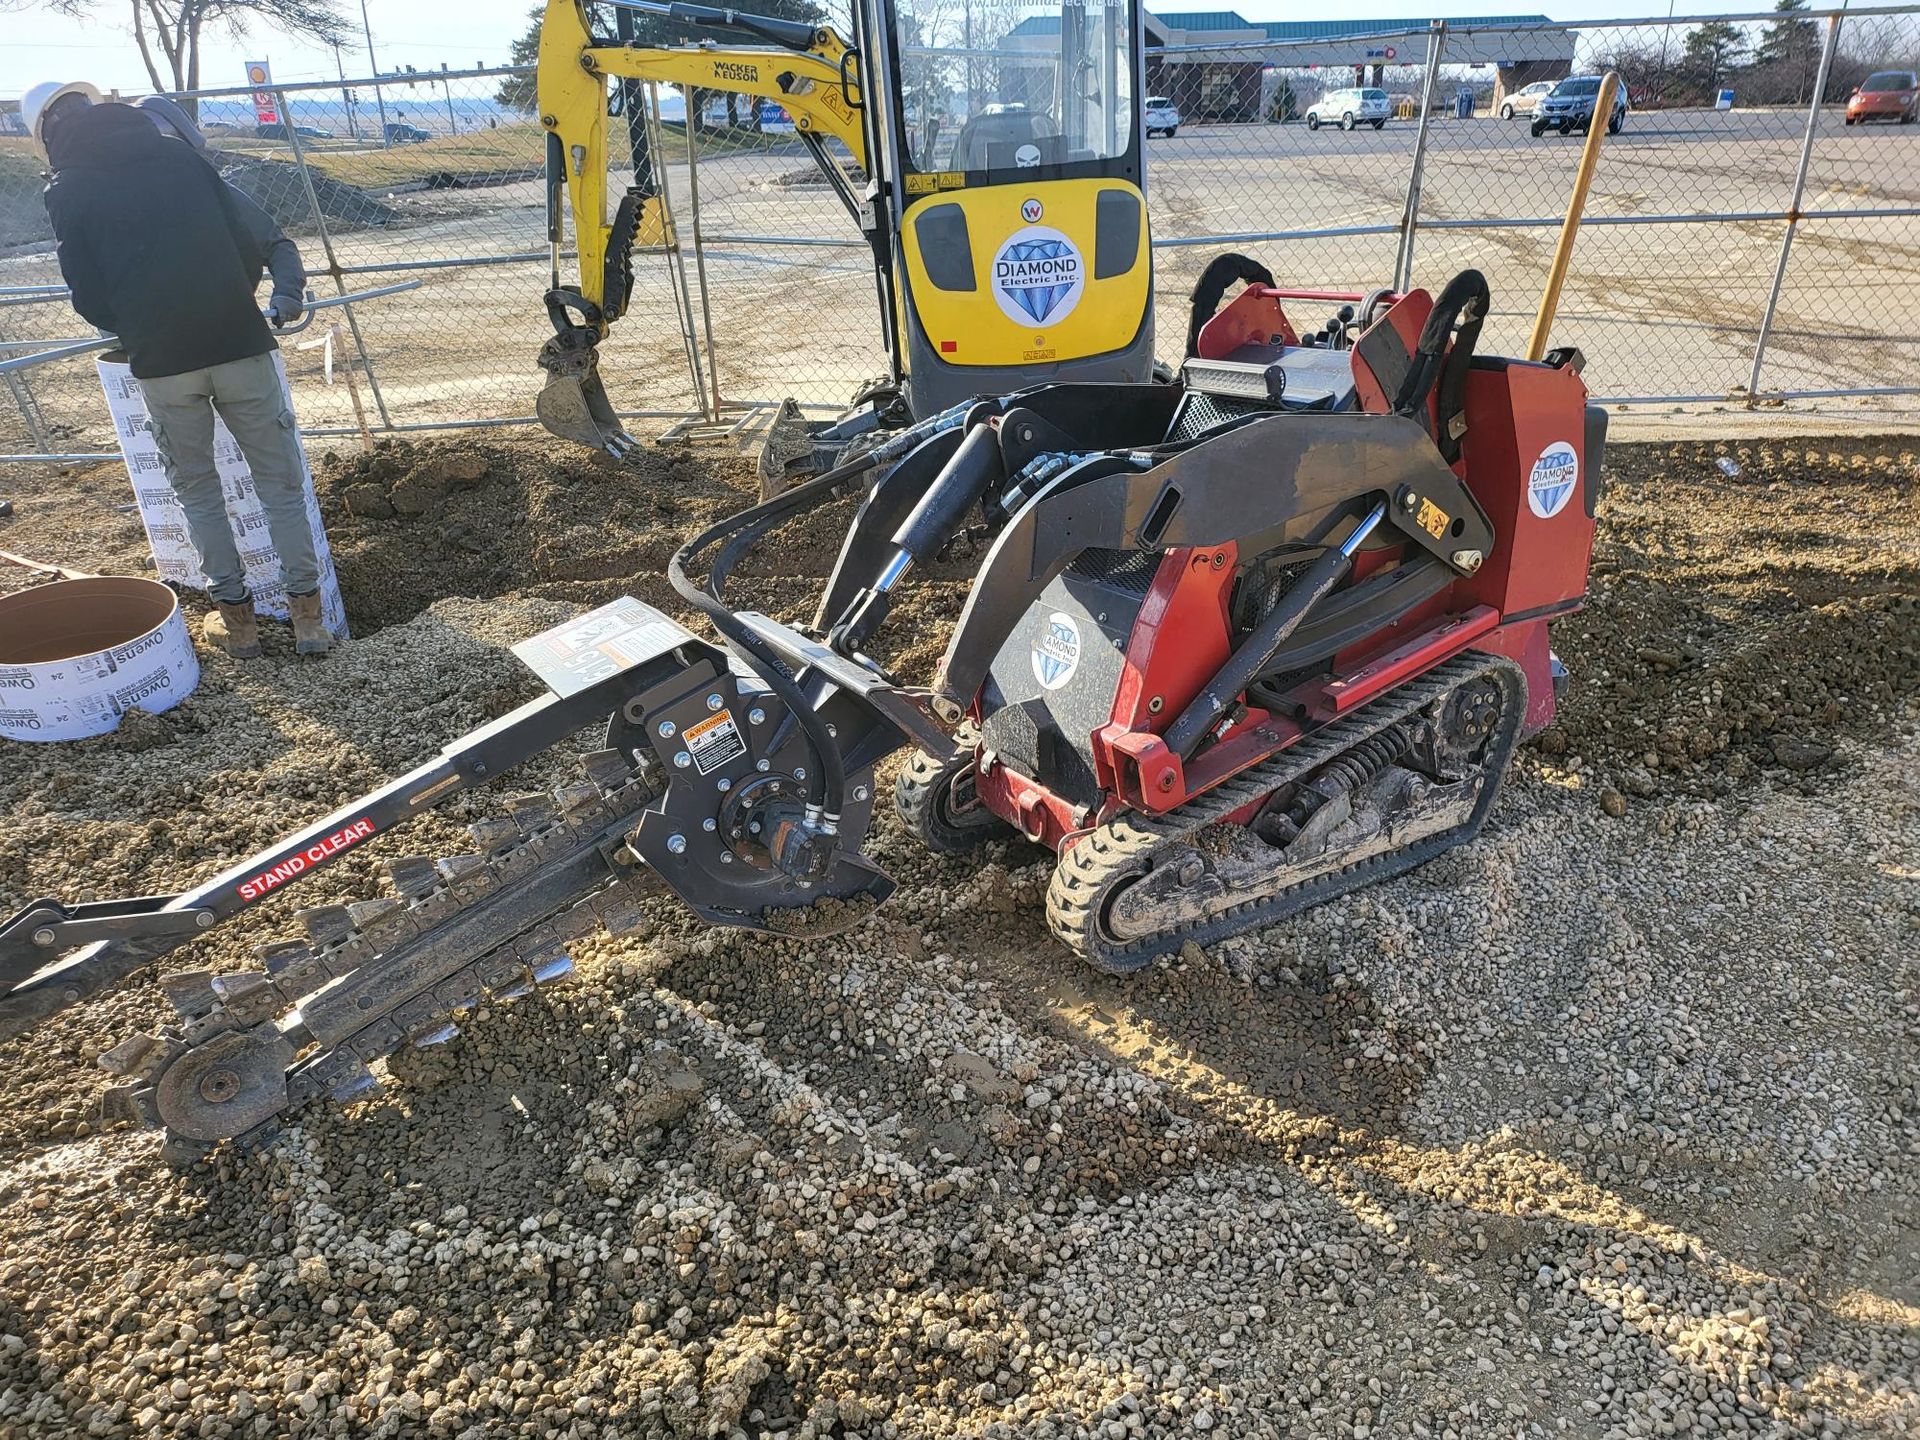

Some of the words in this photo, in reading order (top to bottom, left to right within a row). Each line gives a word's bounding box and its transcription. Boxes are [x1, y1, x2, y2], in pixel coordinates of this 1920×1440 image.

[713, 61, 758, 74] WACKER
[1001, 276, 1050, 287] Electric
[1056, 274, 1080, 283] Inc.
[117, 632, 165, 664] Owens
[1042, 635, 1077, 657] IAMOND
[51, 672, 65, 681] 24
[0, 678, 35, 690] Owe
[122, 676, 171, 708] Owens
[0, 718, 41, 730] Owen
[56, 714, 69, 722] 24
[695, 713, 728, 735] WARNING
[240, 857, 305, 899] STAND
[307, 820, 371, 862] CLEAR
